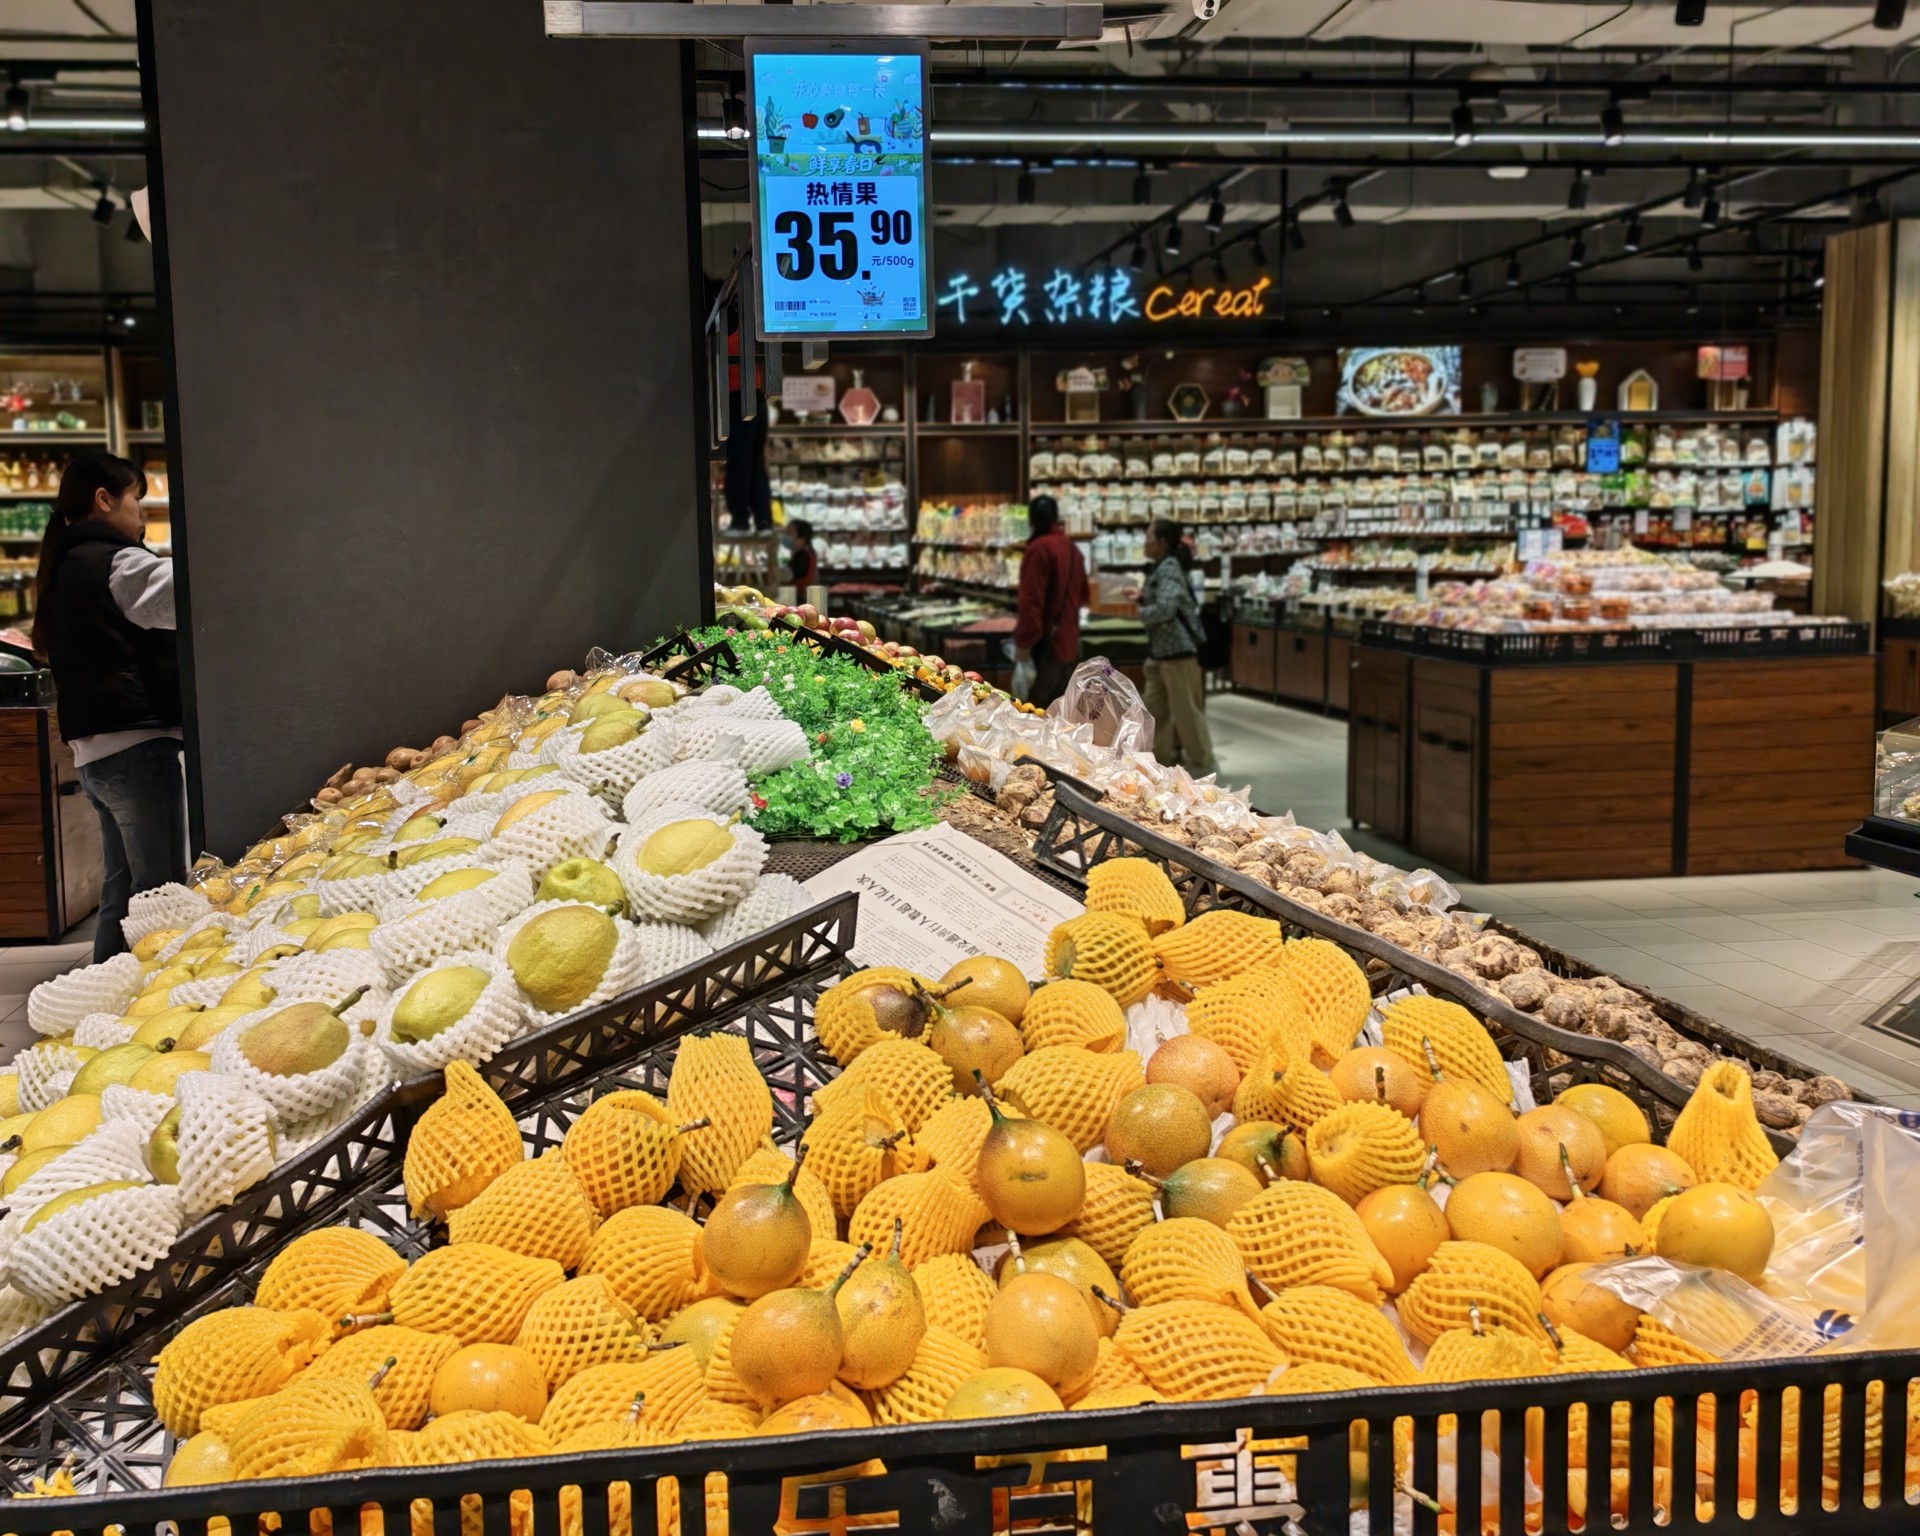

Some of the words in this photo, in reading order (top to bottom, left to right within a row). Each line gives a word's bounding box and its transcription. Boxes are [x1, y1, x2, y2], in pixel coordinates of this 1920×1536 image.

[805, 155, 874, 176] 鲜享春日
[806, 182, 878, 206] 热情果
[871, 256, 914, 268] 元/500g
[937, 267, 1141, 326] 干货杂粮
[856, 873, 986, 957] 周交通出行人数超14亿人次
